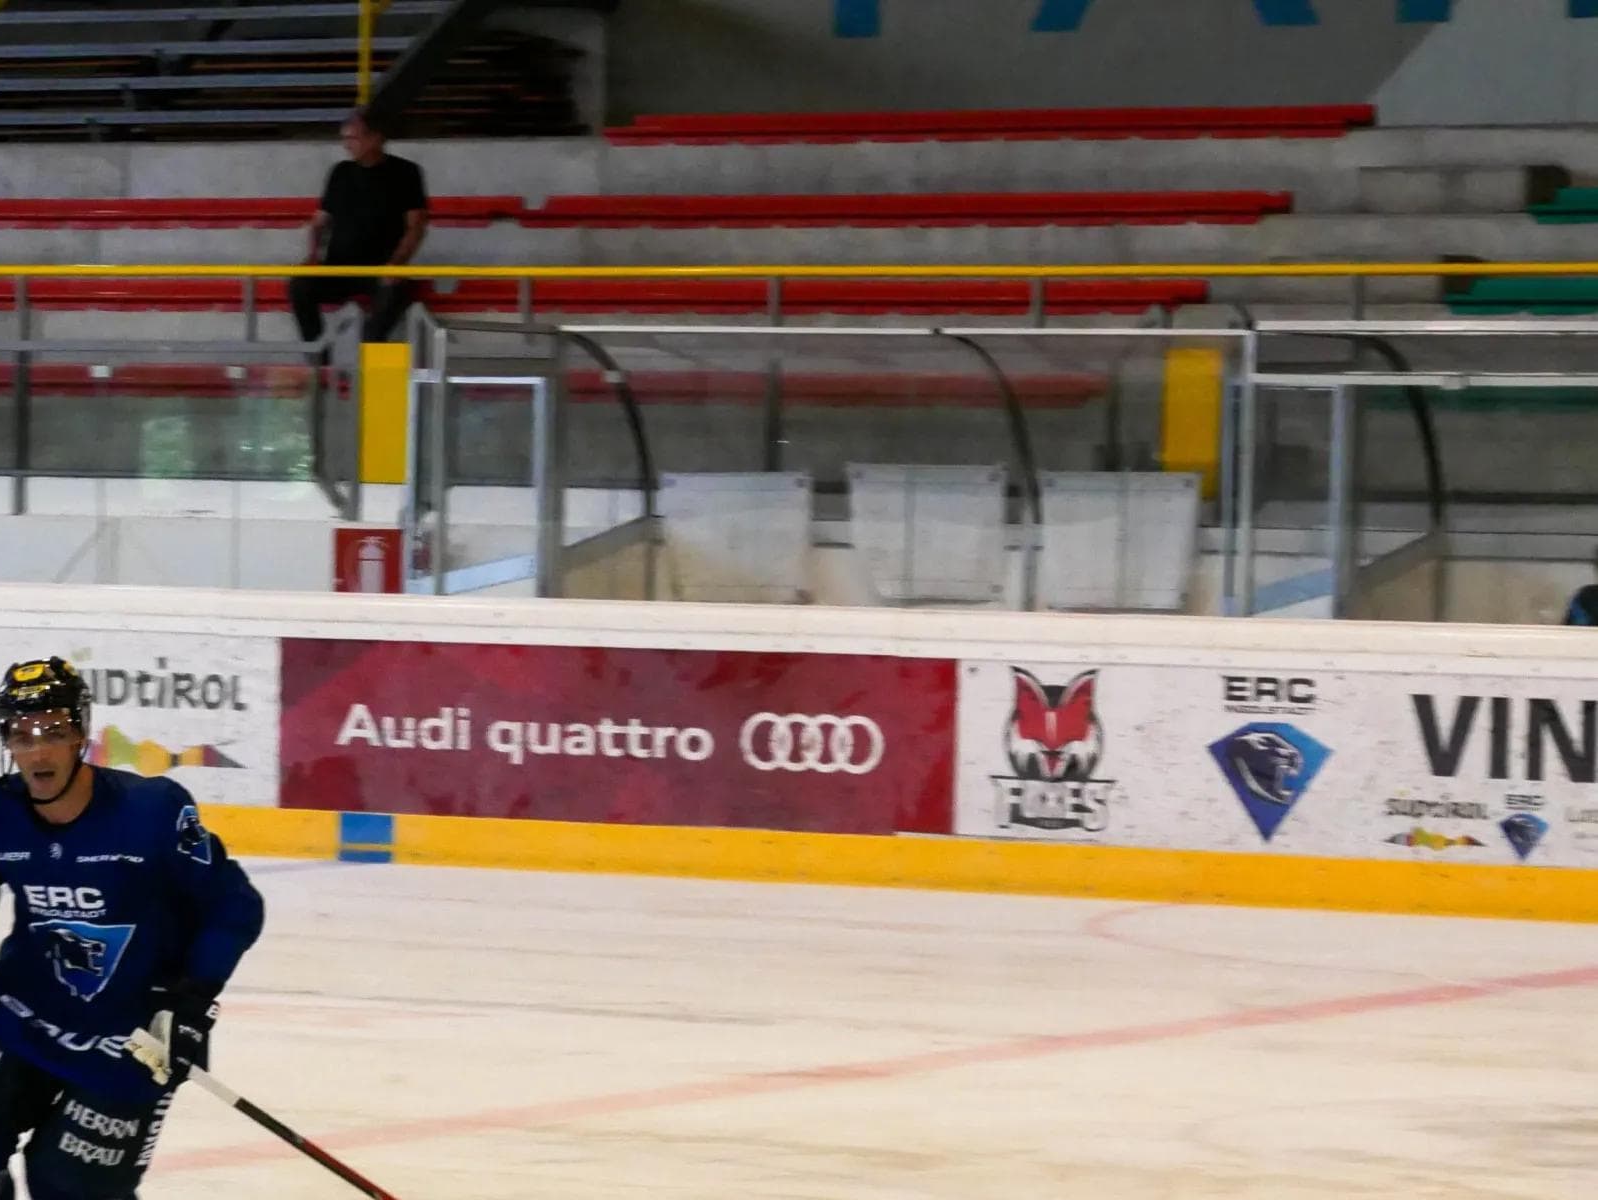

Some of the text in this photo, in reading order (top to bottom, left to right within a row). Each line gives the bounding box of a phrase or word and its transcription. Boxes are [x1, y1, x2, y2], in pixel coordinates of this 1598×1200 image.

[1223, 675, 1317, 703] ERC
[335, 703, 715, 765] Audi quattro
[1411, 693, 1598, 784] VIN
[22, 884, 105, 909] ERC
[64, 1100, 140, 1139] HERRN
